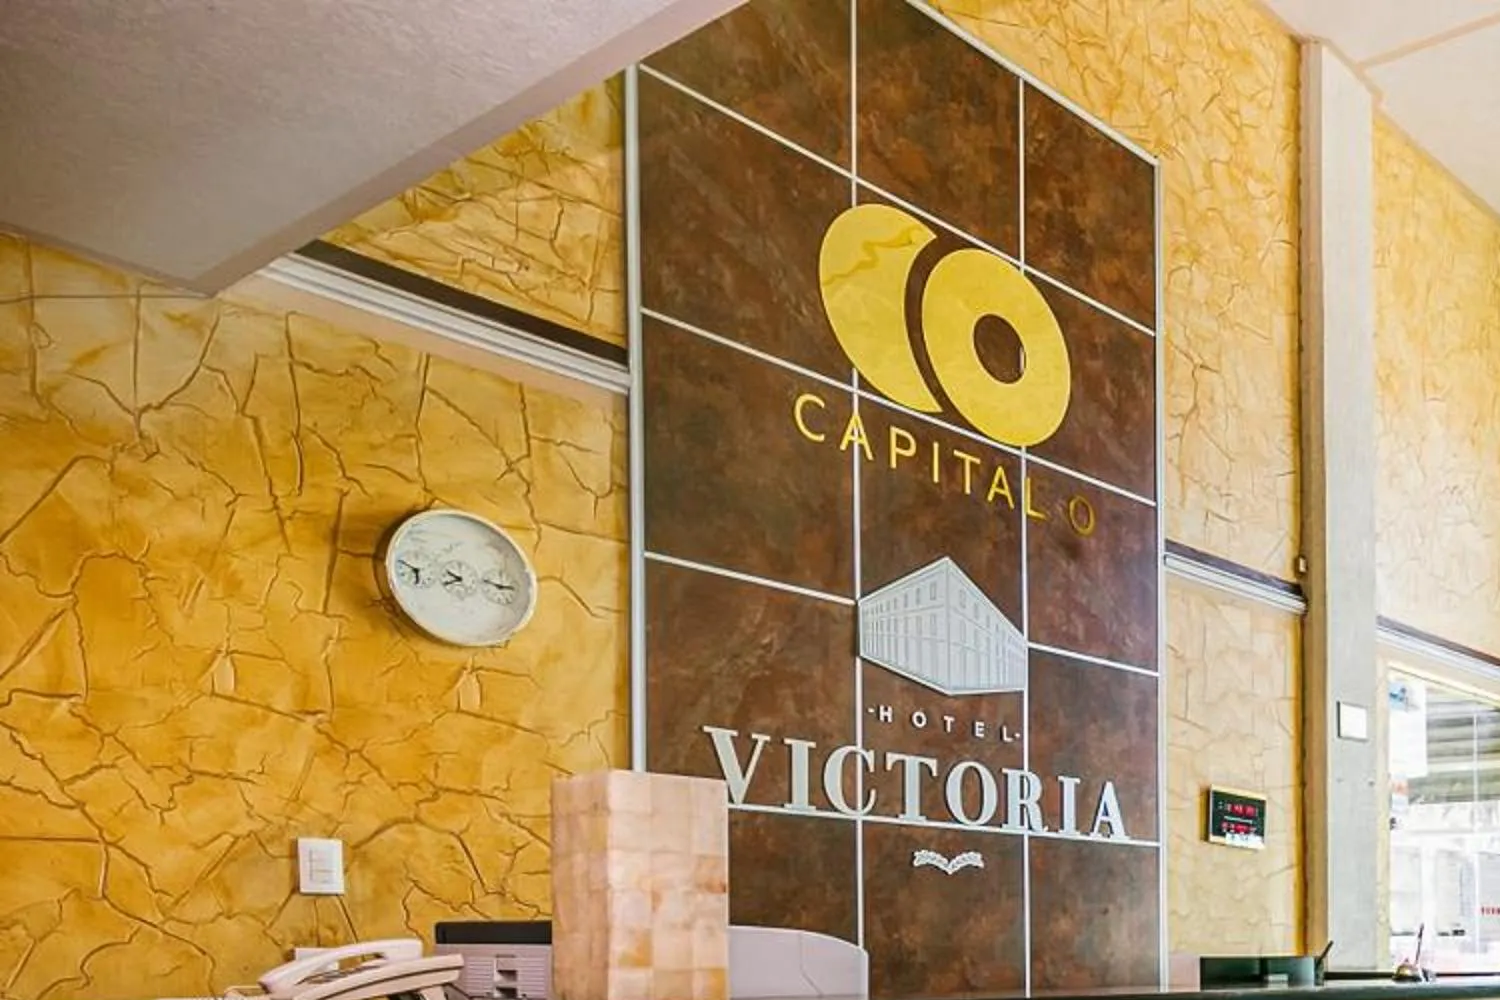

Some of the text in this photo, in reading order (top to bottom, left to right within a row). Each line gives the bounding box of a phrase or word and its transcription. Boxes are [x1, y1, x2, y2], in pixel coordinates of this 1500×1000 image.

[793, 393, 1097, 536] CAPITAL O
[879, 704, 1014, 743] HOTEL
[703, 725, 1131, 843] VICTORIA
